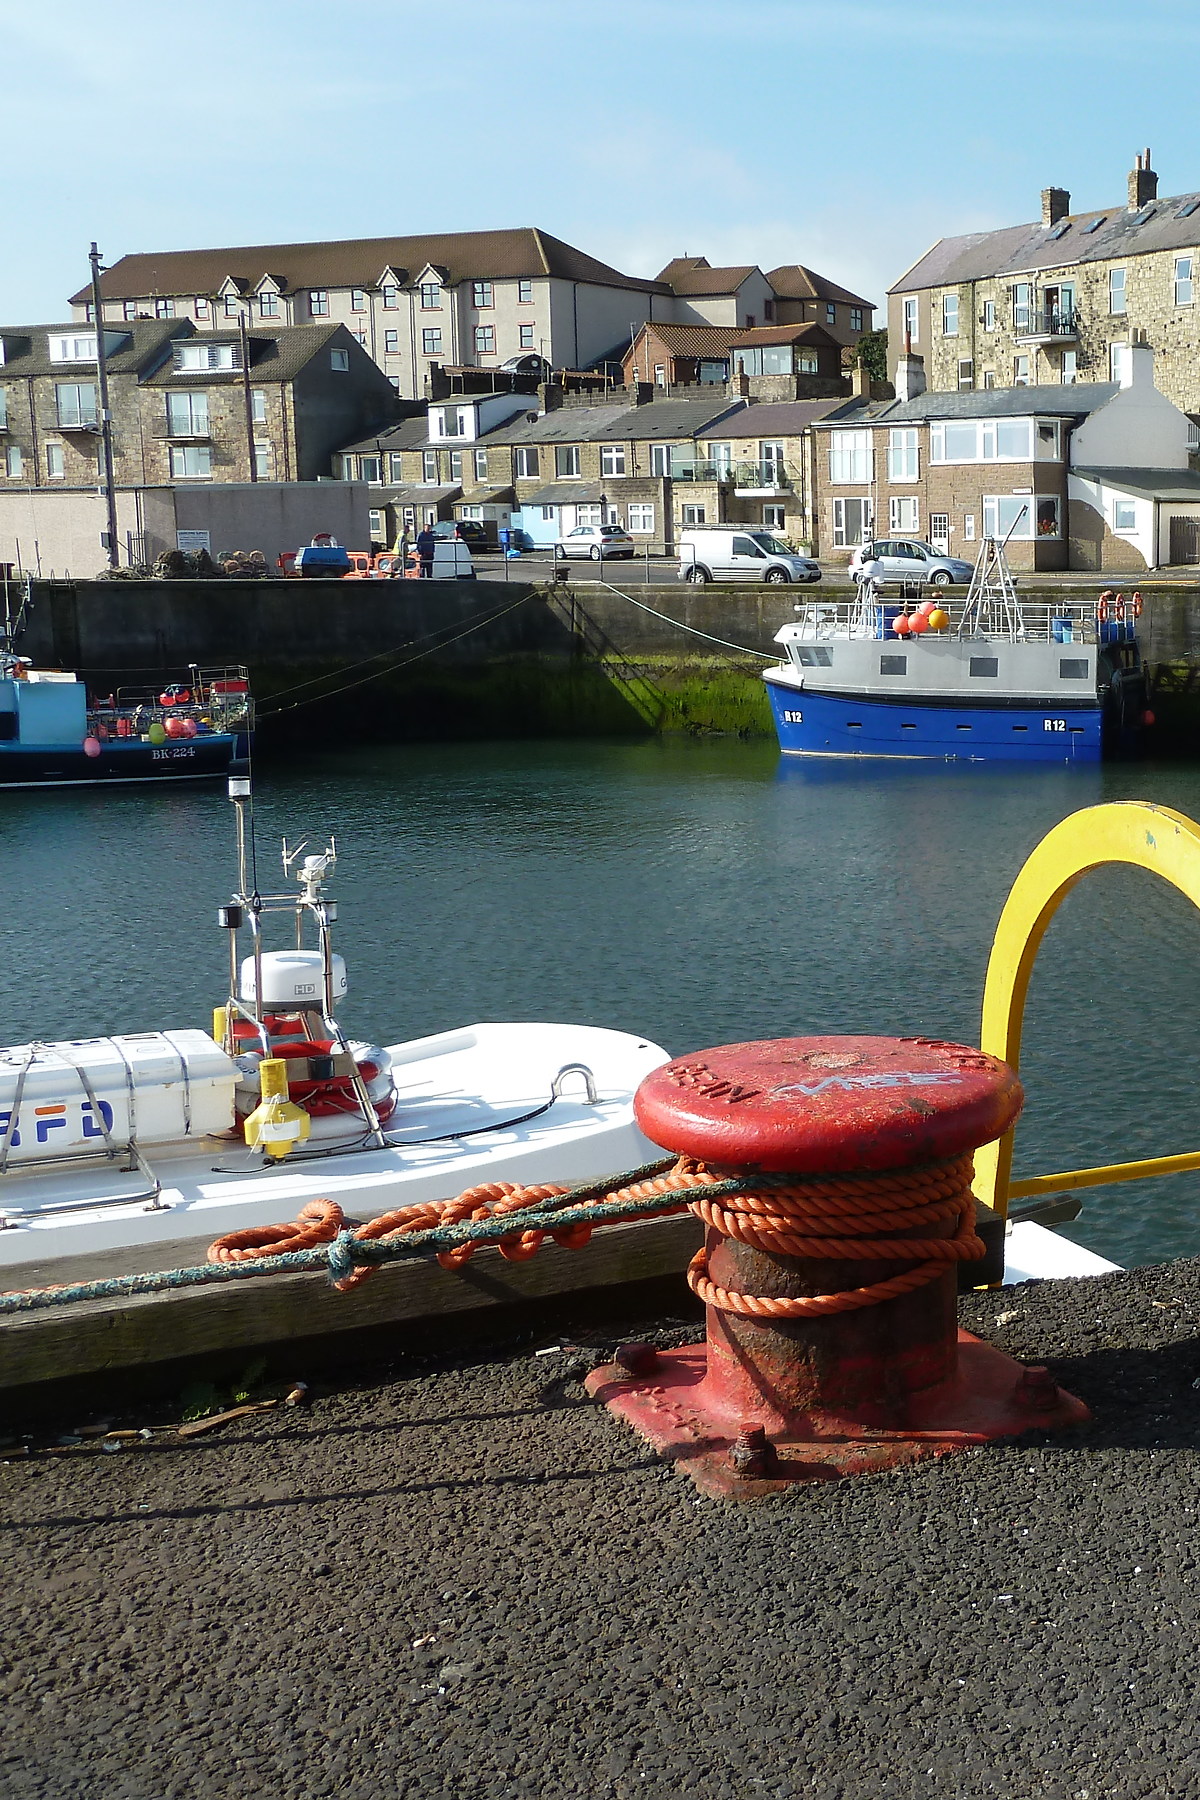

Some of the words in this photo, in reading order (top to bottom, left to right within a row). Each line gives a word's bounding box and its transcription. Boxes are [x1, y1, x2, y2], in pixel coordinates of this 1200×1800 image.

[784, 710, 803, 723] R12
[1044, 719, 1066, 732] R12
[152, 746, 196, 760] BK-224
[295, 984, 315, 995] HD
